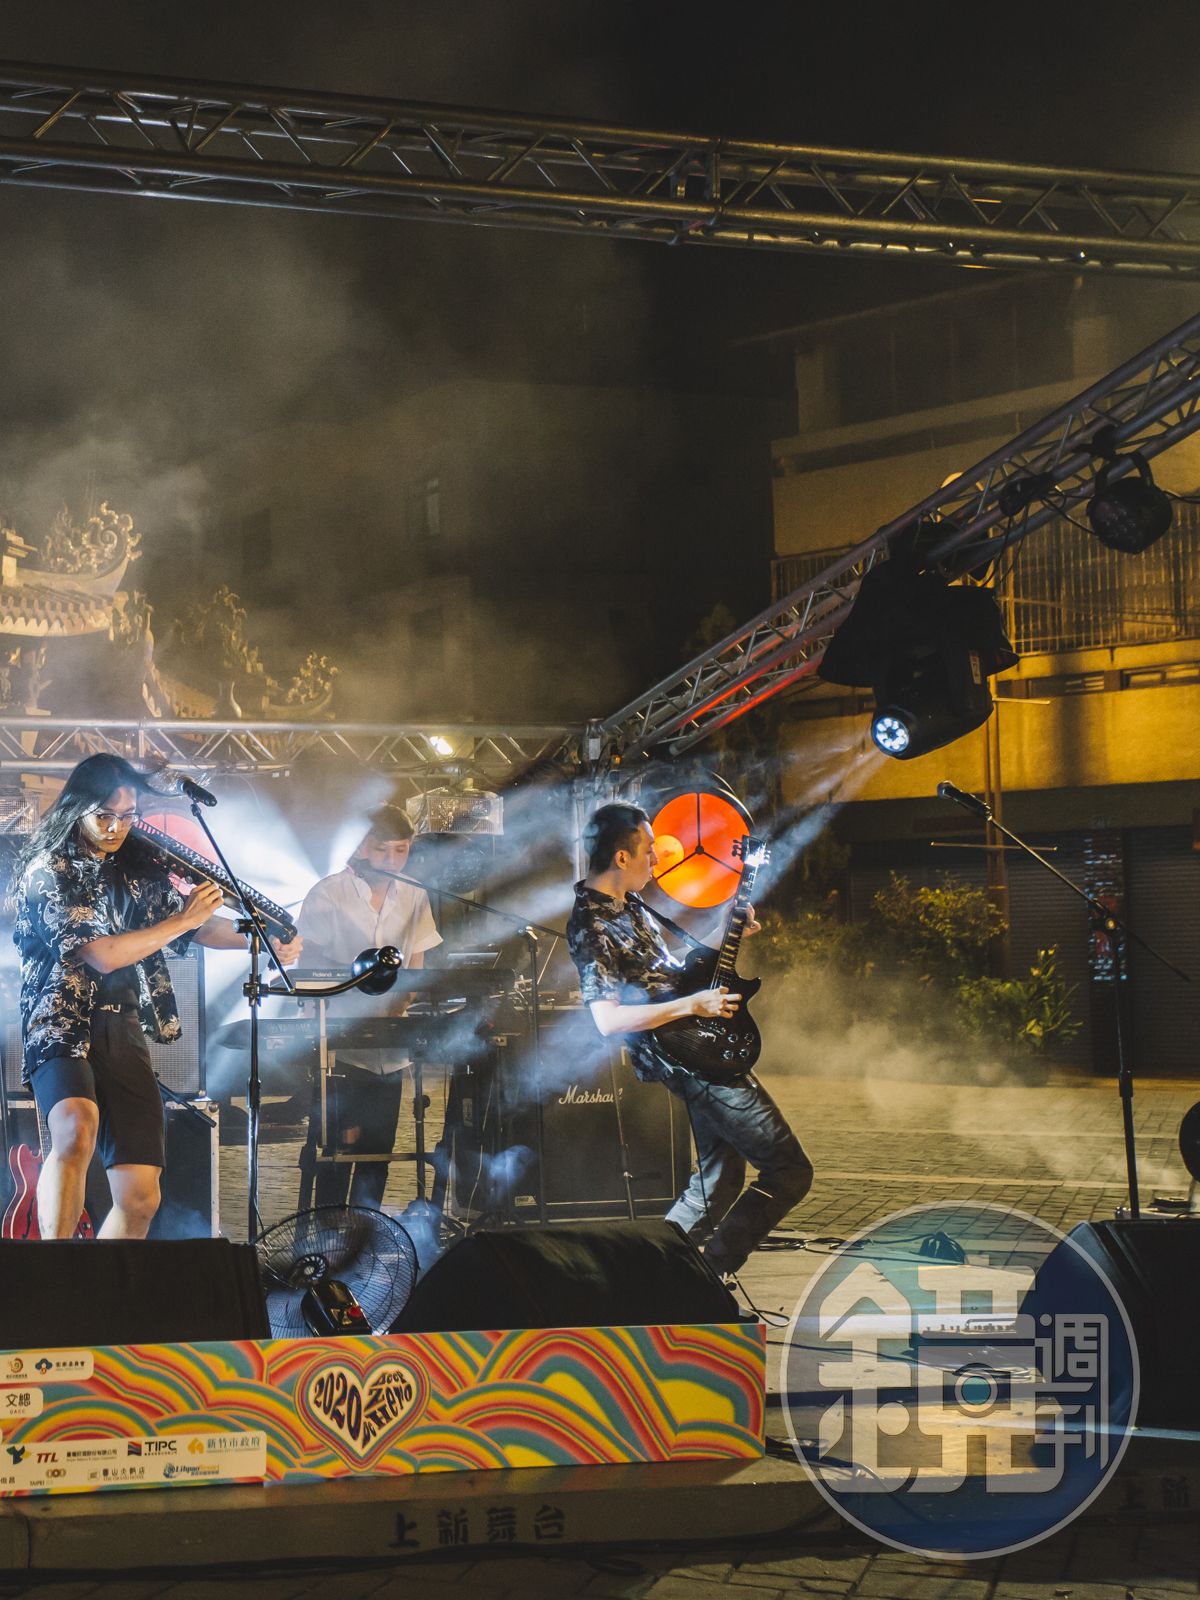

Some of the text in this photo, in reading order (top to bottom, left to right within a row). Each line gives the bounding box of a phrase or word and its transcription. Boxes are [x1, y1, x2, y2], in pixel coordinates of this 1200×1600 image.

[313, 1371, 362, 1441] 2020
[144, 1440, 178, 1452] TIPC
[207, 1436, 261, 1449] 新竹市政府
[36, 1452, 59, 1464] TTL
[389, 1504, 566, 1548] 上新舞台
